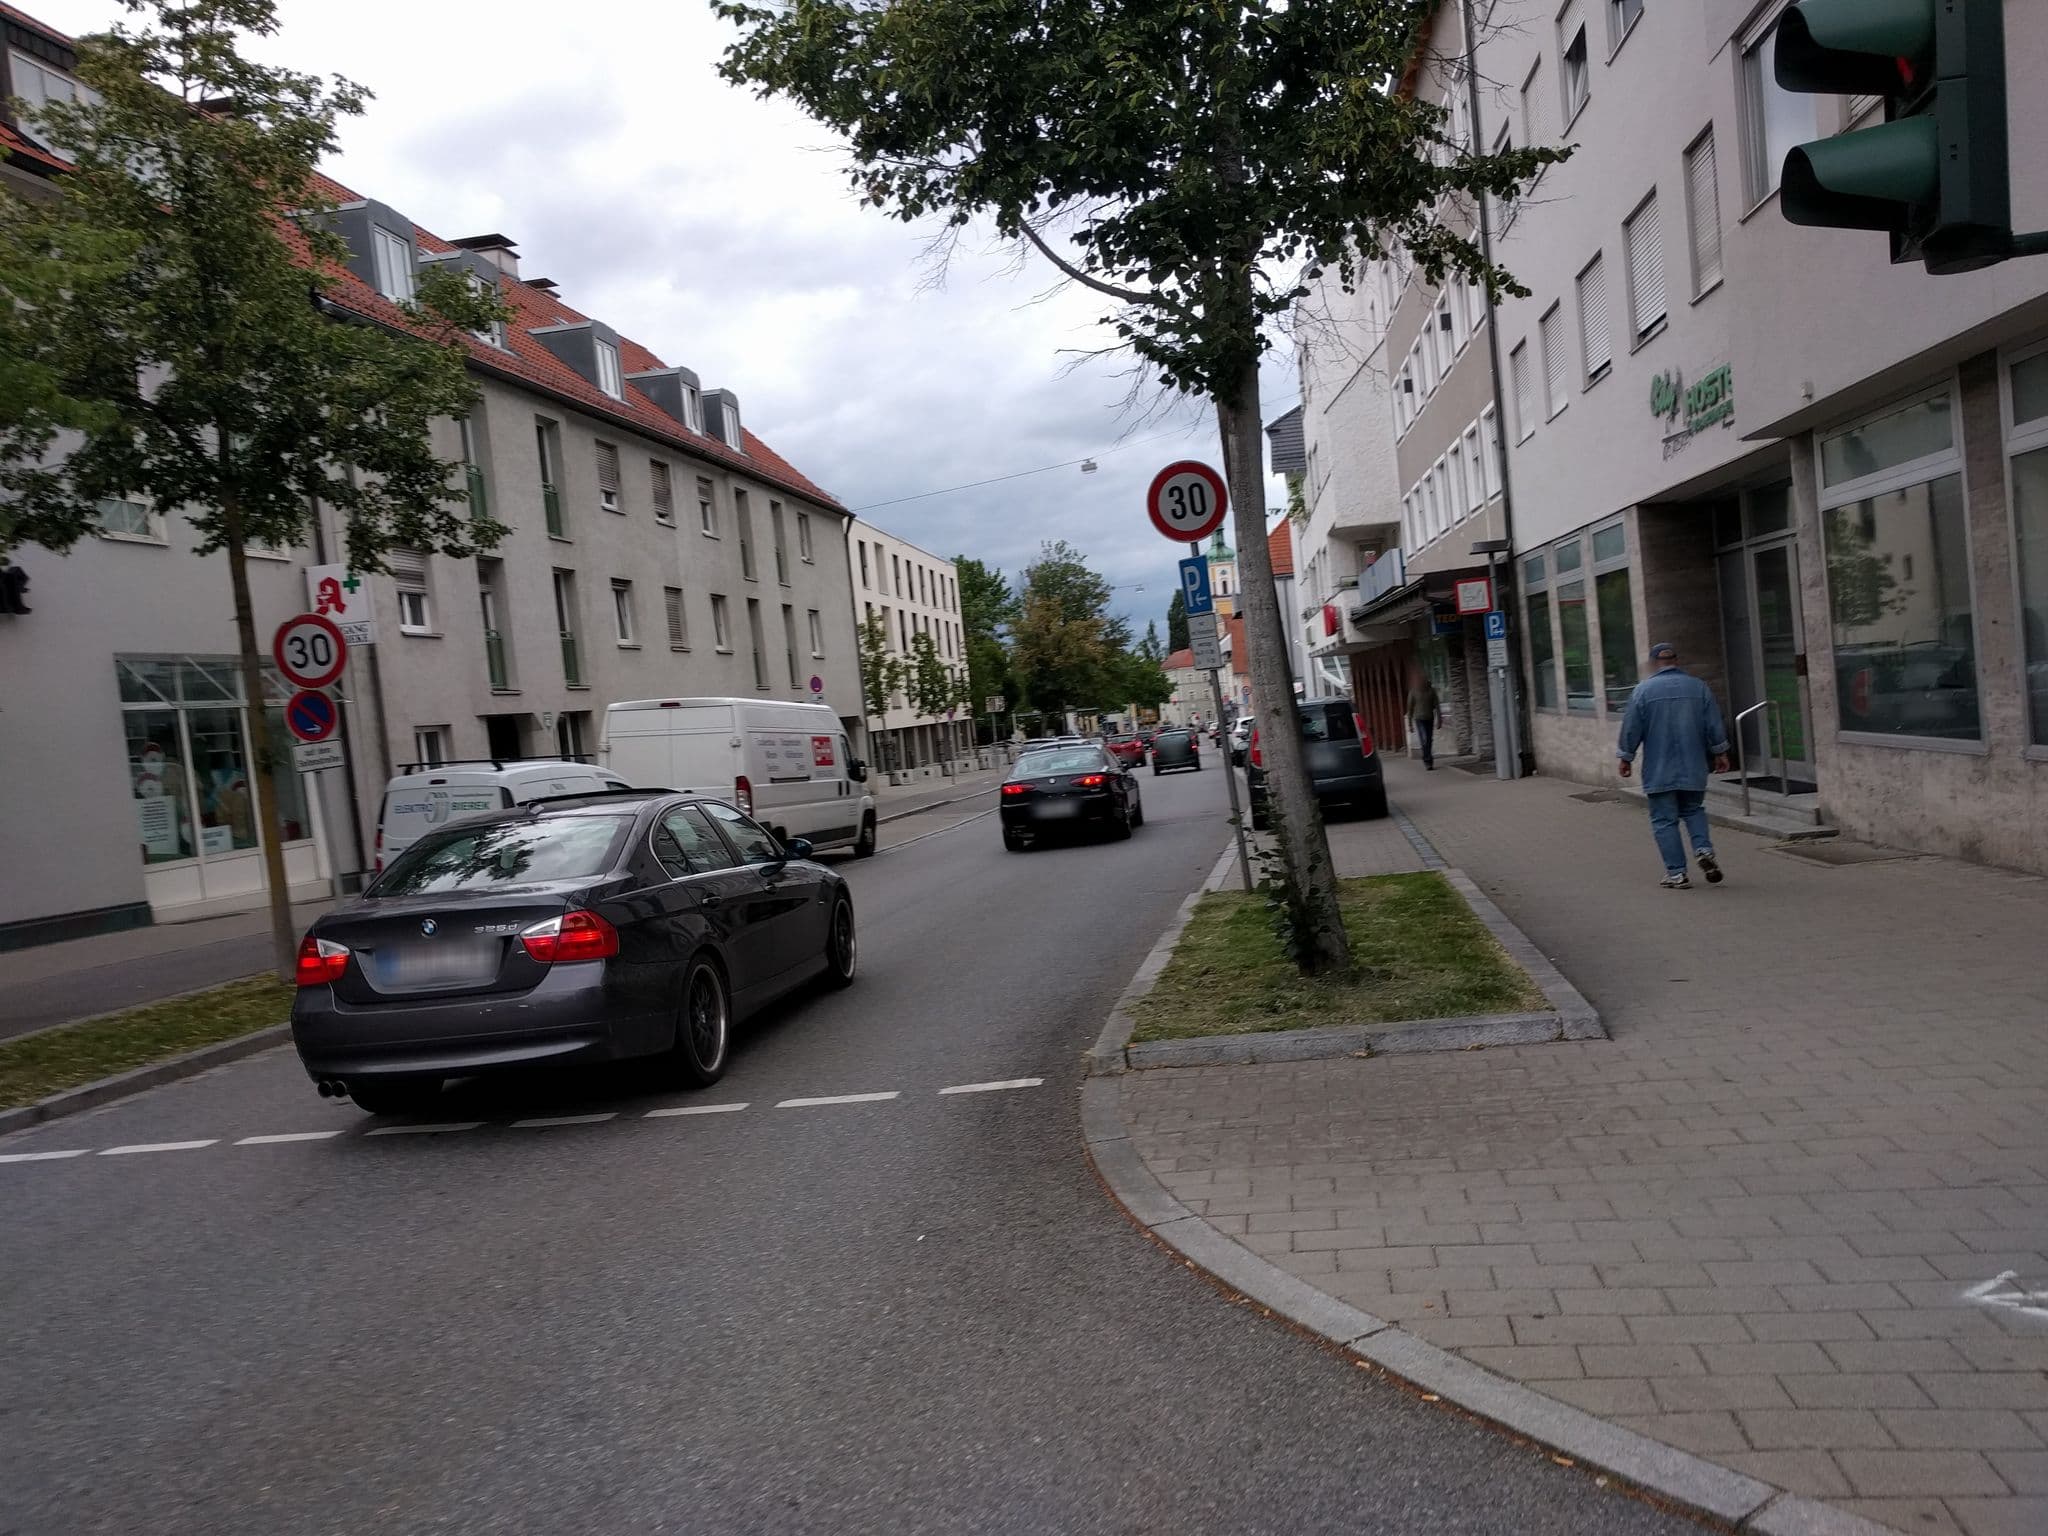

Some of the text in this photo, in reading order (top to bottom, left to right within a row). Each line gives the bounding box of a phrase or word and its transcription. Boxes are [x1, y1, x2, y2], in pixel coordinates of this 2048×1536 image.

[1168, 482, 1207, 520] 30
[1183, 565, 1201, 608] P
[1488, 614, 1501, 637] P
[287, 633, 332, 670] 30
